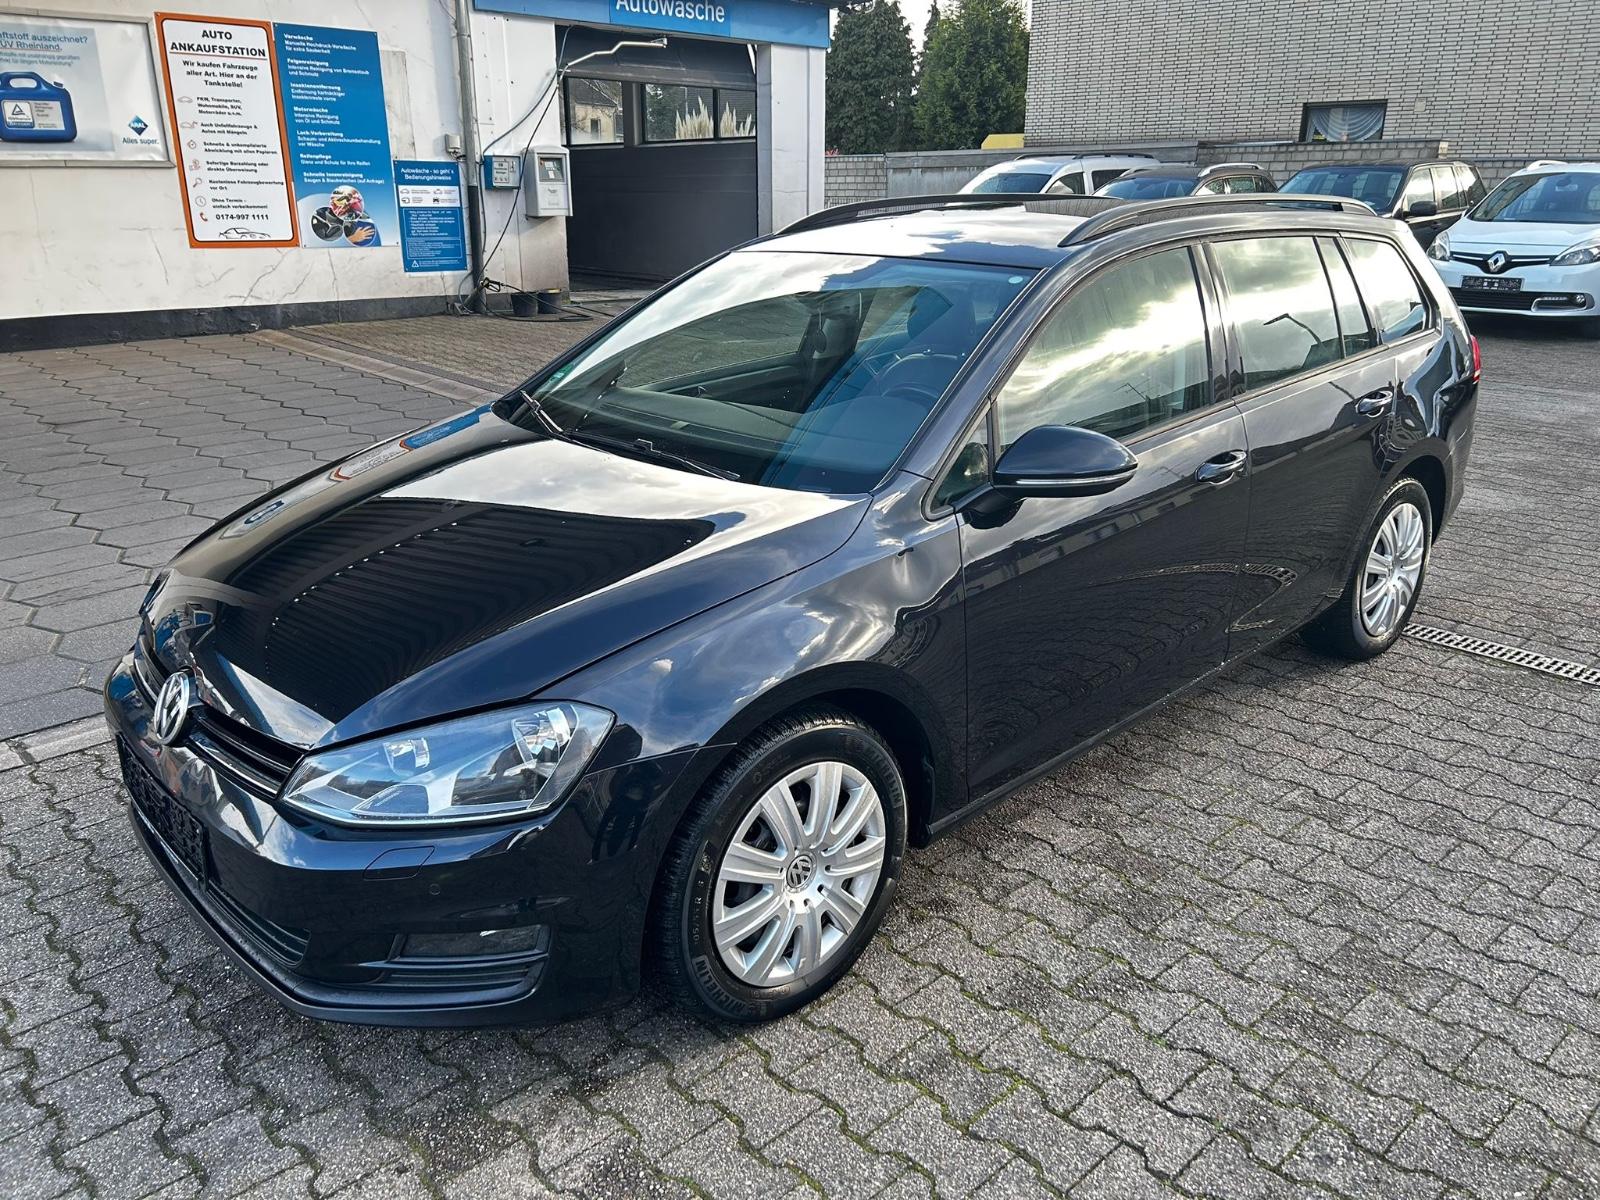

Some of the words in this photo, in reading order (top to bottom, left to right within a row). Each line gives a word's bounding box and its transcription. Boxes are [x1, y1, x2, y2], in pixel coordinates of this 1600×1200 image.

[32, 34, 87, 44] auszeichnet?
[202, 30, 232, 40] AUTO
[16, 40, 62, 50] Rheinland.
[170, 42, 266, 57] ANKAUFSTATION
[222, 63, 258, 71] Fahrzeuge
[287, 58, 328, 66] Felgenreinigung
[290, 82, 341, 91] Insektenentfernung
[694, 957, 748, 1014] MICHELIN
